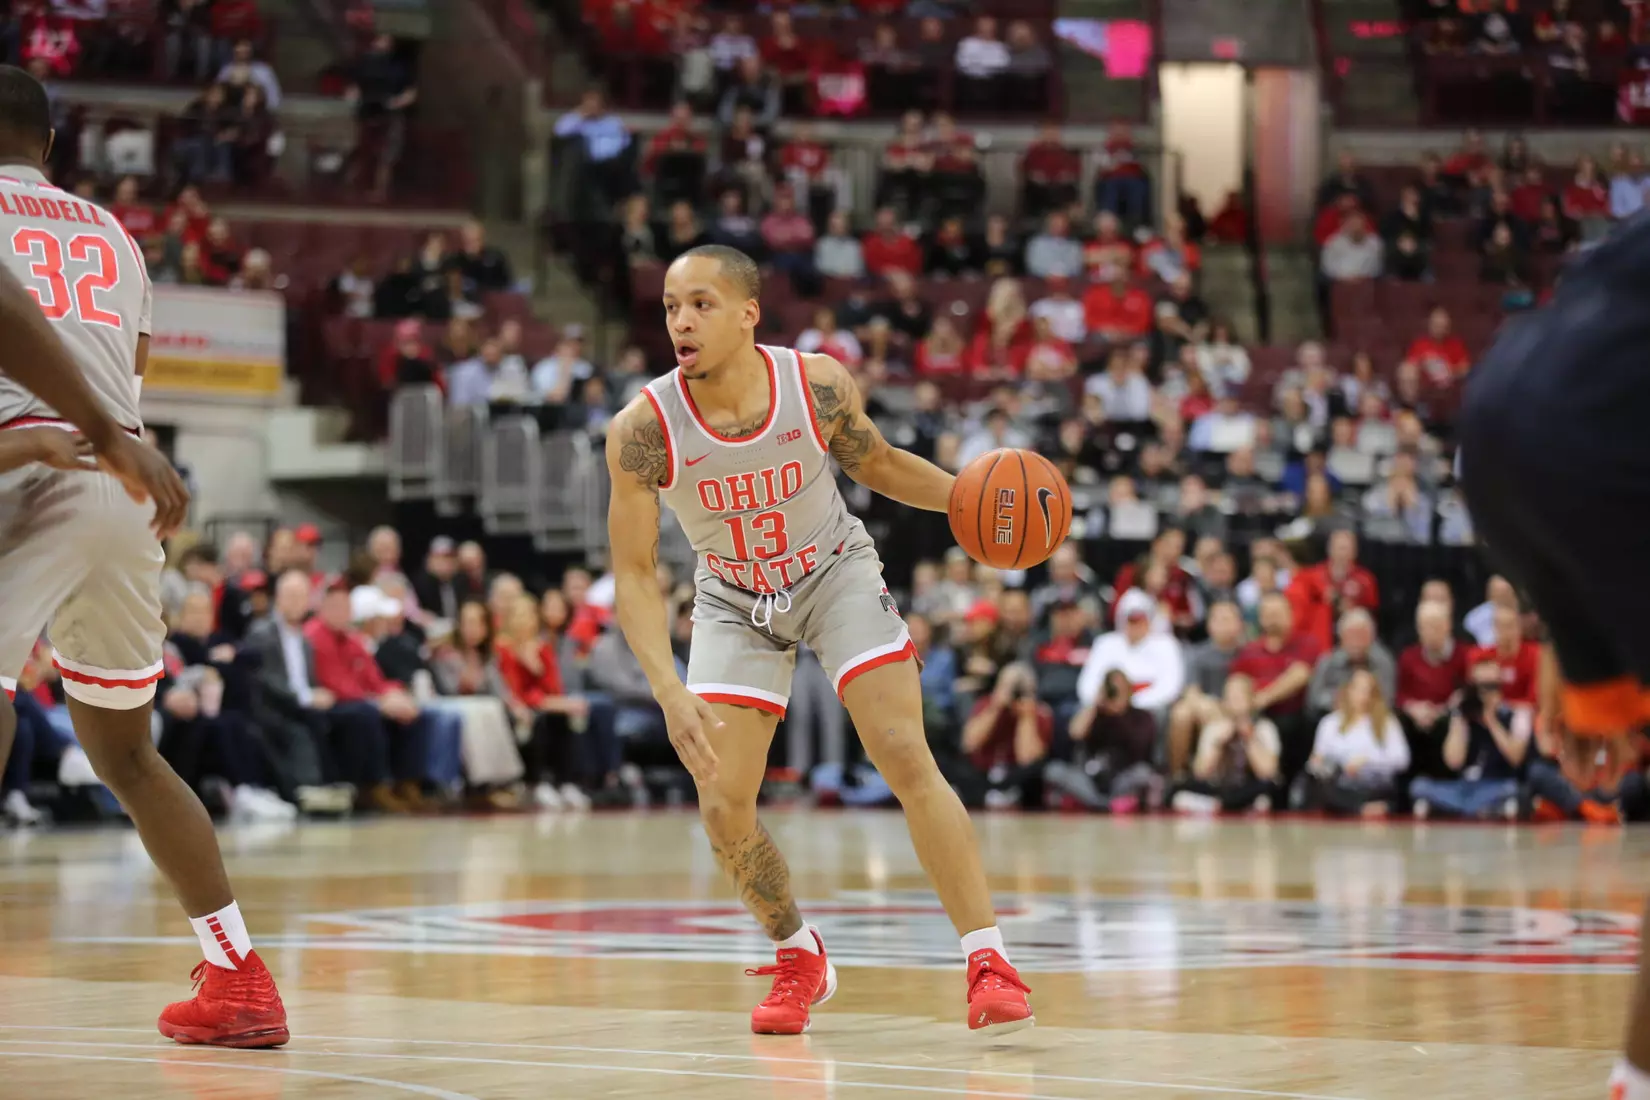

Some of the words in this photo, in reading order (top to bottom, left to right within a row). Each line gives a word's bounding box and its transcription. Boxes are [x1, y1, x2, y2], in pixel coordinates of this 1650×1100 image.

[0, 192, 106, 228] LIDDELL
[11, 226, 123, 330] 32
[696, 459, 804, 513] OHIO
[723, 510, 789, 563] 13
[996, 487, 1016, 545] ELITE
[705, 544, 819, 595] STATE
